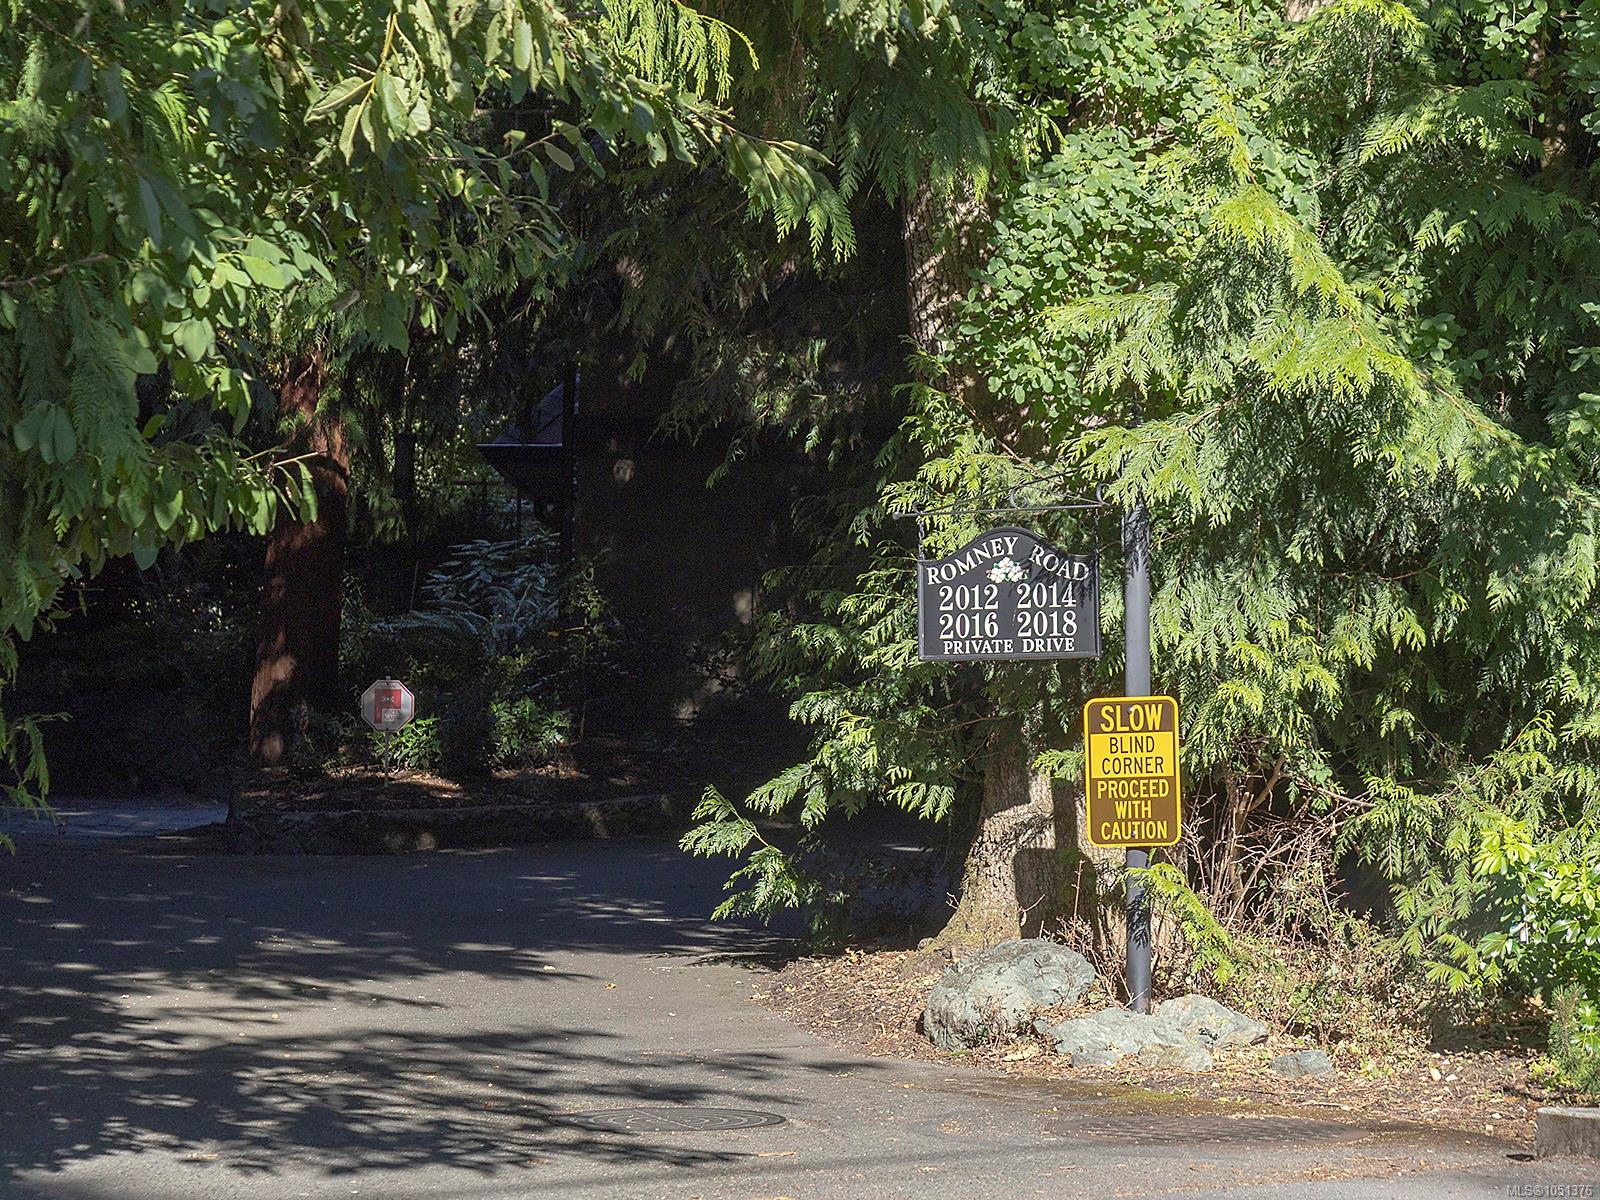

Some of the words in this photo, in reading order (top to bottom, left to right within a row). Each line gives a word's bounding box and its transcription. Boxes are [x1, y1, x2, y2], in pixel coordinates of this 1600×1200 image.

[927, 536, 1018, 585] ROMNEY
[1028, 544, 1089, 581] ROAD
[939, 584, 999, 611] 2012
[1016, 582, 1077, 609] 2014
[939, 612, 999, 640] 2016
[1017, 610, 1078, 638] 2018
[943, 639, 1014, 654] PRIVATE
[1022, 637, 1075, 653] DRIVE
[1100, 703, 1163, 732] SLOW
[1110, 736, 1155, 754] BLIND
[1101, 756, 1164, 775] CORNER
[1097, 779, 1169, 799] PROCEED
[1114, 799, 1152, 819] WITH
[1101, 820, 1168, 841] CAUTION
